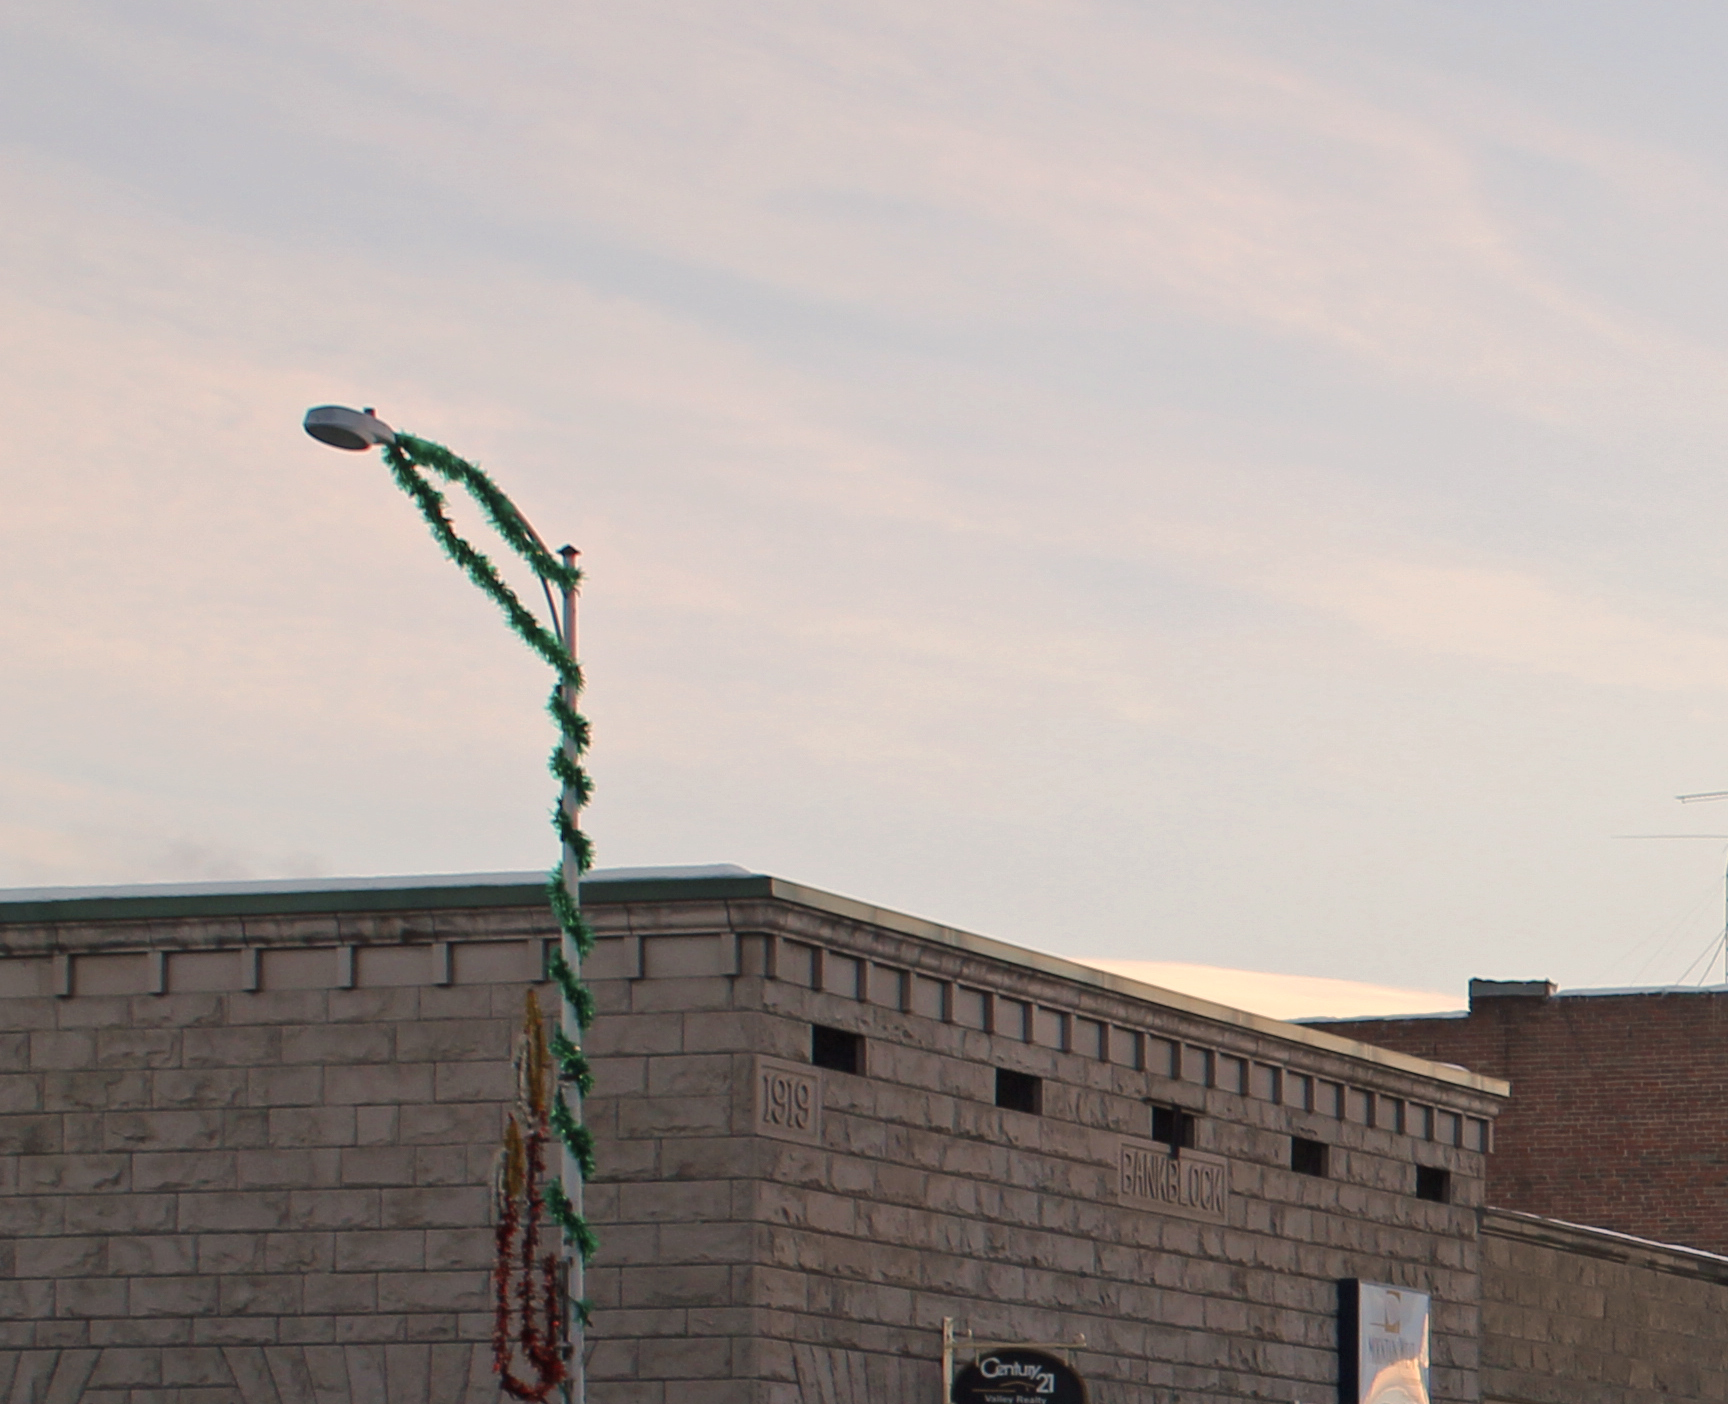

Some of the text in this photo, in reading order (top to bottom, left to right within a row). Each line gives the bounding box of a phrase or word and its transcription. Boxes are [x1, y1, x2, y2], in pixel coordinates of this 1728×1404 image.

[763, 1074, 811, 1130] 1919
[980, 1357, 1042, 1379] Century
[1036, 1373, 1055, 1393] 21
[985, 1394, 1014, 1404] Valley
